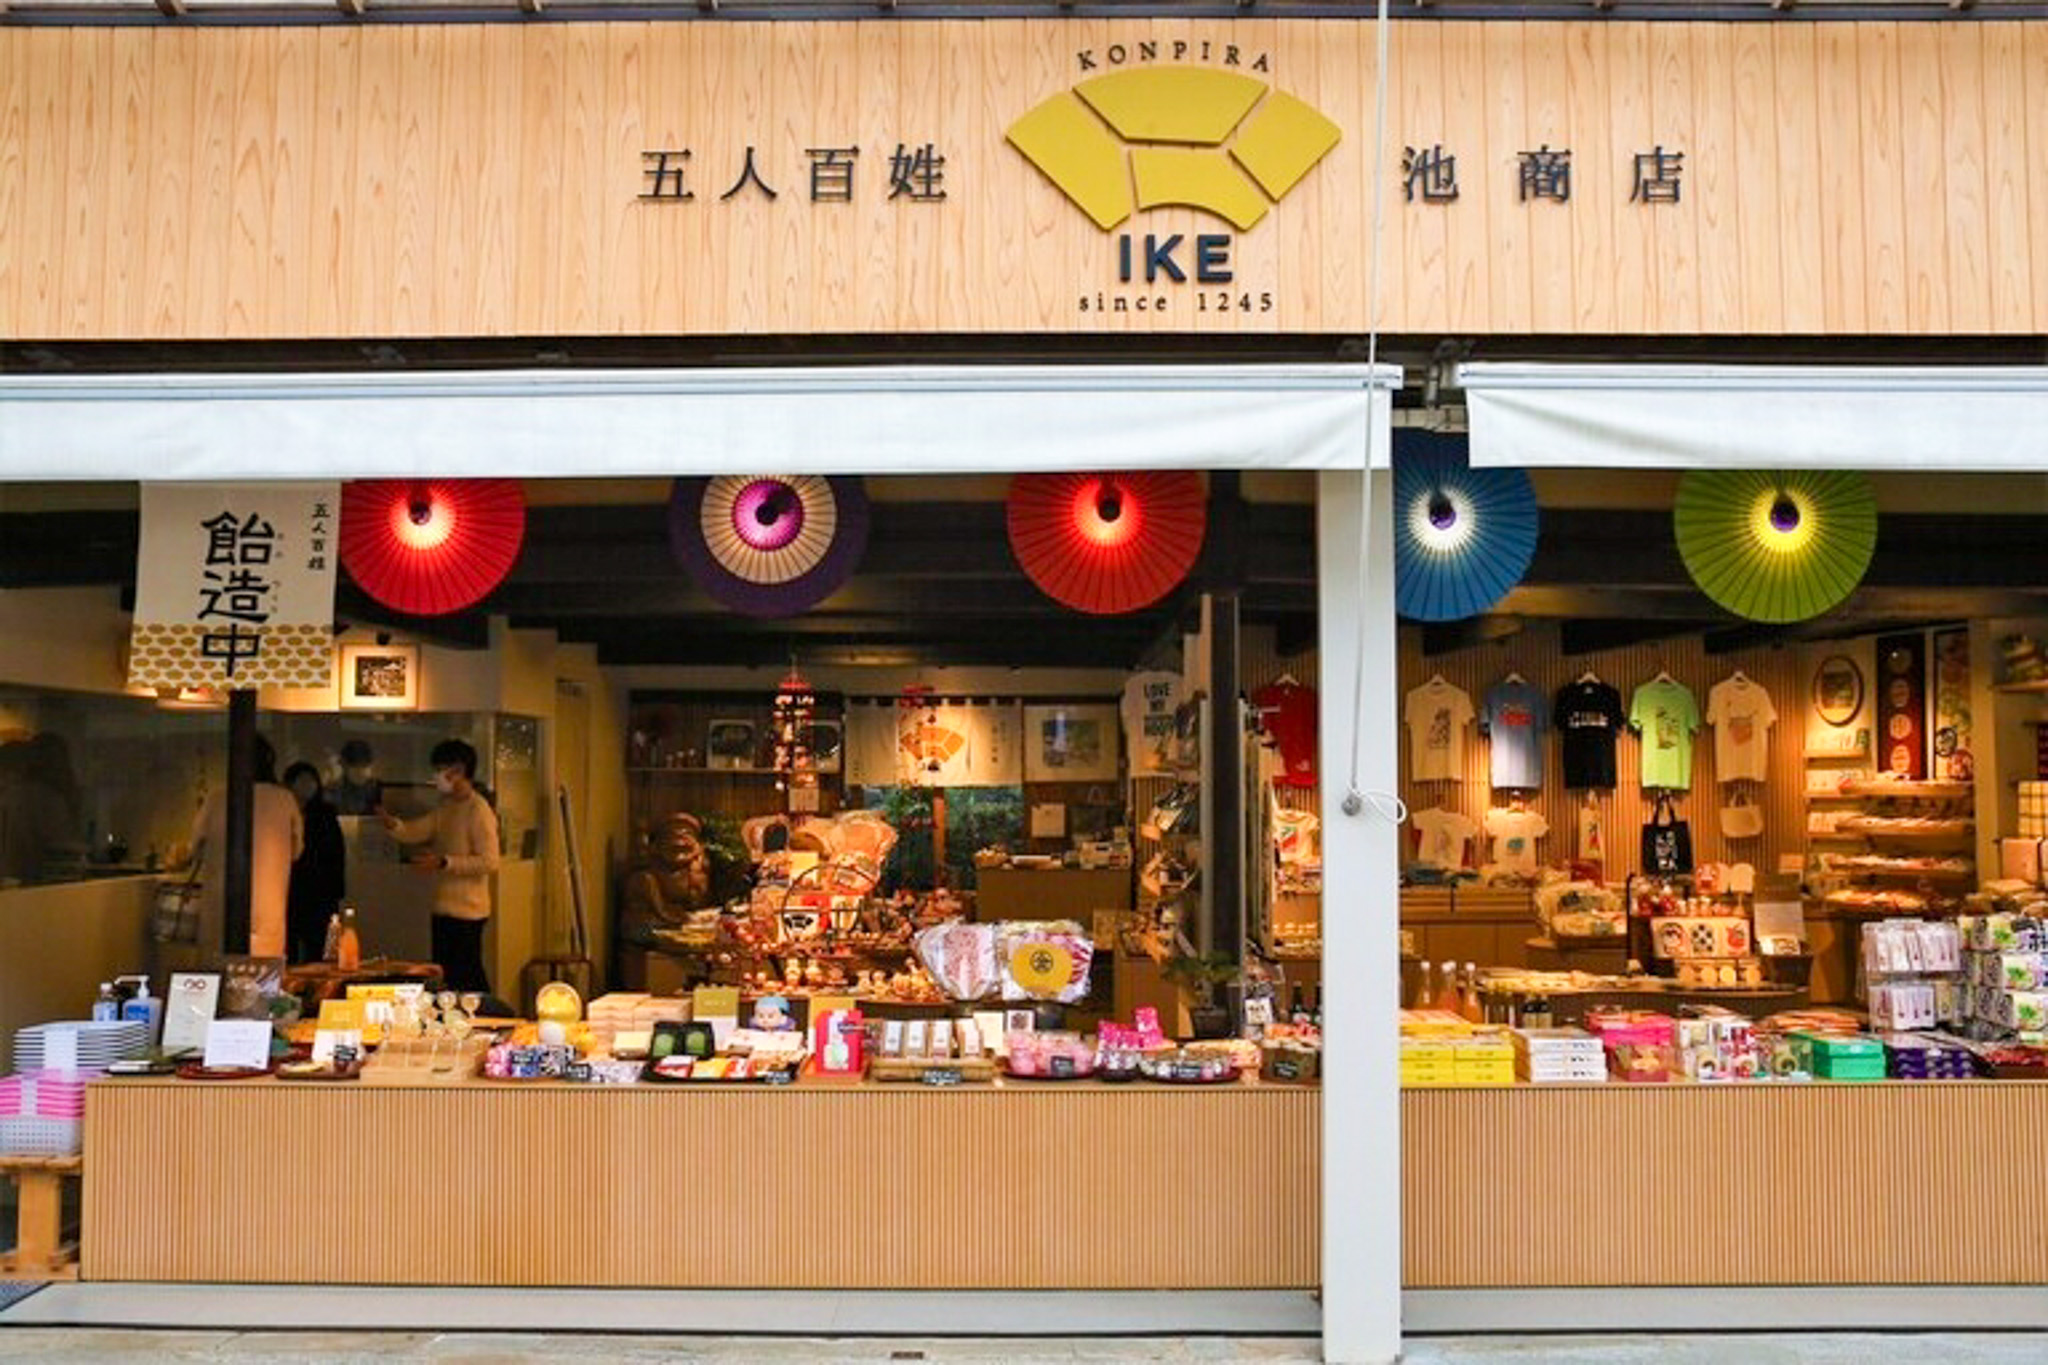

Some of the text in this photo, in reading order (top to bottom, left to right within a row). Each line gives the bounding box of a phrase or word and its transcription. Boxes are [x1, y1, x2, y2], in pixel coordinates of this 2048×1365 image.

[1077, 41, 1269, 72] KONPIRA
[638, 143, 947, 202] 五人百姓
[1402, 145, 1685, 203] 池商店
[1119, 234, 1233, 283] IKE
[1079, 293, 1272, 312] since 1245
[197, 511, 275, 678] 飴造中
